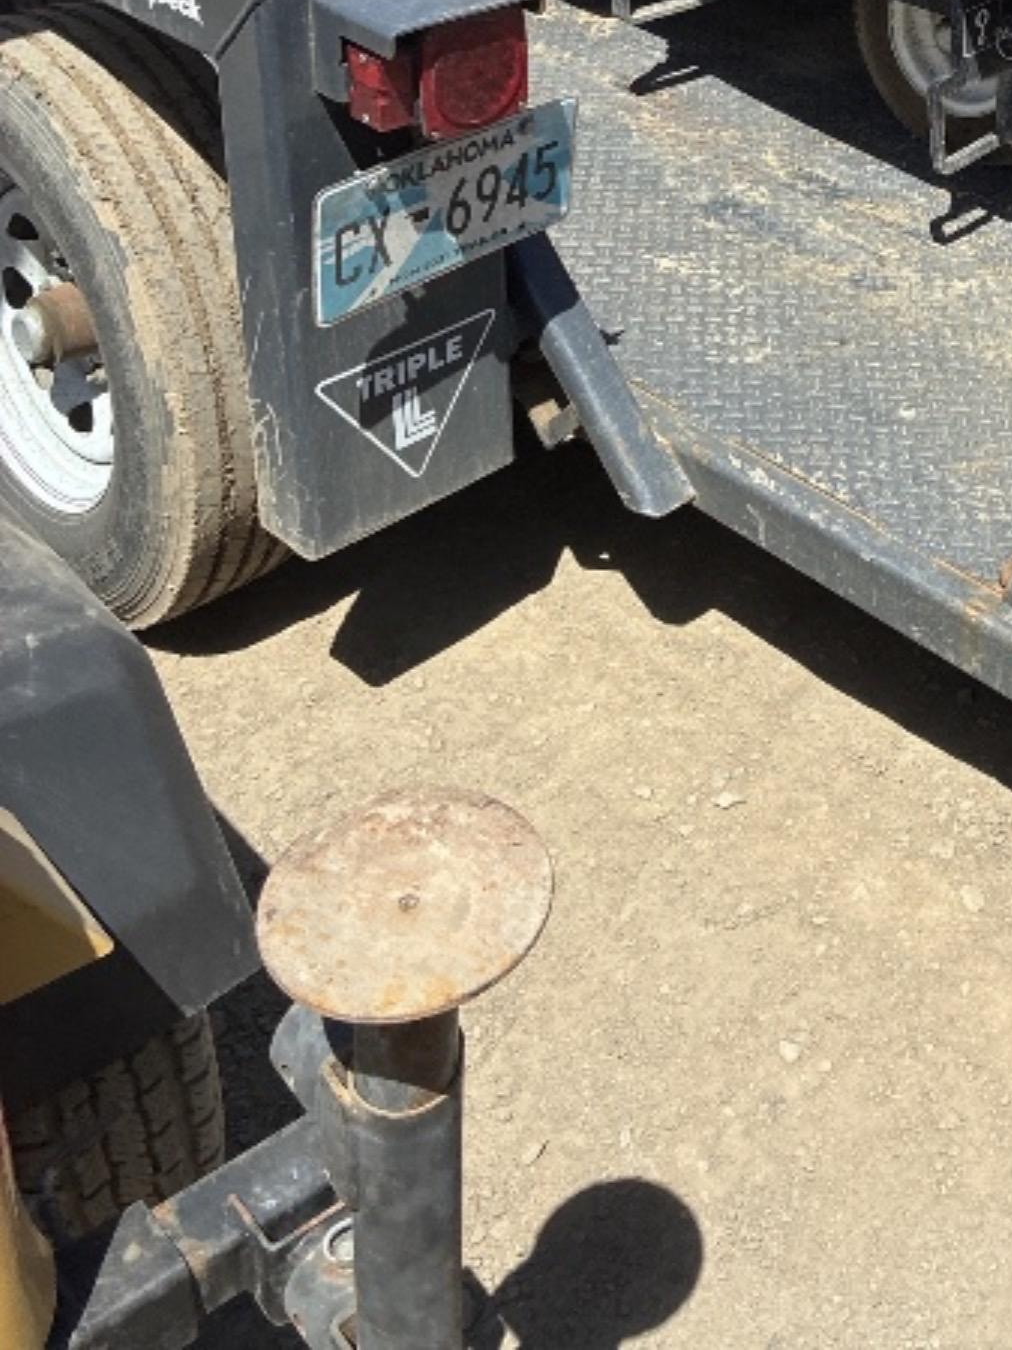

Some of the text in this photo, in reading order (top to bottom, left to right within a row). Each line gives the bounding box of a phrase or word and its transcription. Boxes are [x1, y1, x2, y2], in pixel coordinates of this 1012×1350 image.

[384, 129, 515, 193] OKLAHOMA
[445, 140, 559, 236] 6945
[356, 335, 464, 401] TRIPLE
